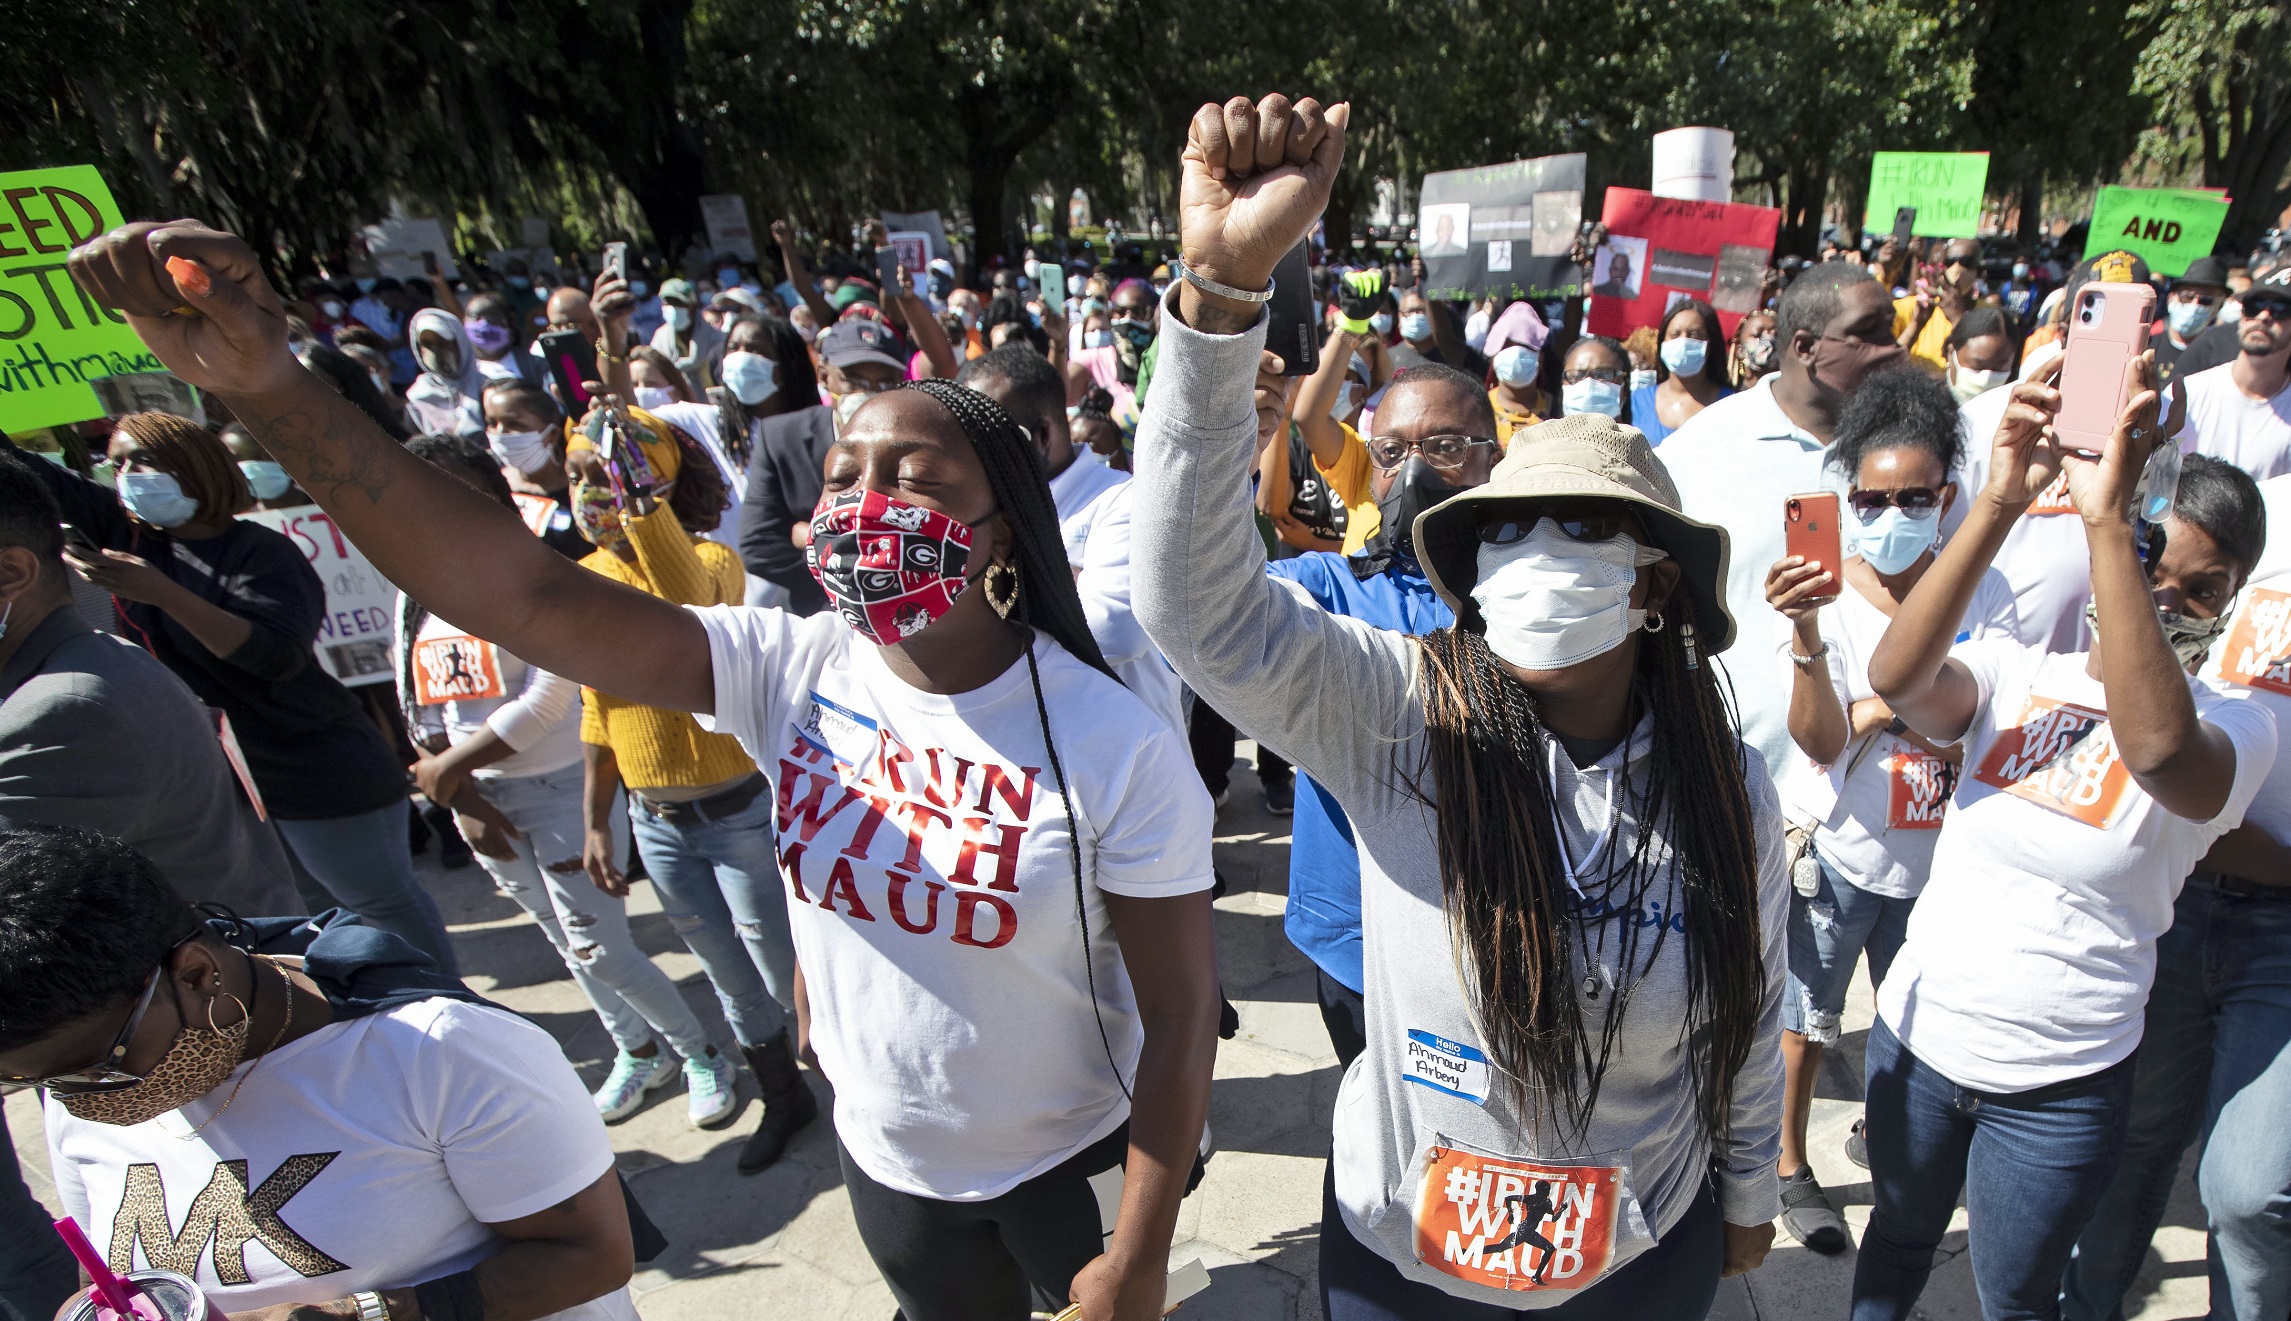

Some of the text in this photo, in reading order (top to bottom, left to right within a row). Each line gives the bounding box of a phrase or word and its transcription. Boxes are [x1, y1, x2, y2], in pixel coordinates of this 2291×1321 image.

[2122, 216, 2181, 243] AND
[282, 513, 348, 562] ST
[778, 758, 1028, 893] WITH
[1408, 1041, 1467, 1072] Ahmaud
[1436, 1037, 1460, 1052] Hello
[1416, 1060, 1460, 1090] Arbery
[1444, 1230, 1584, 1278] MAUD
